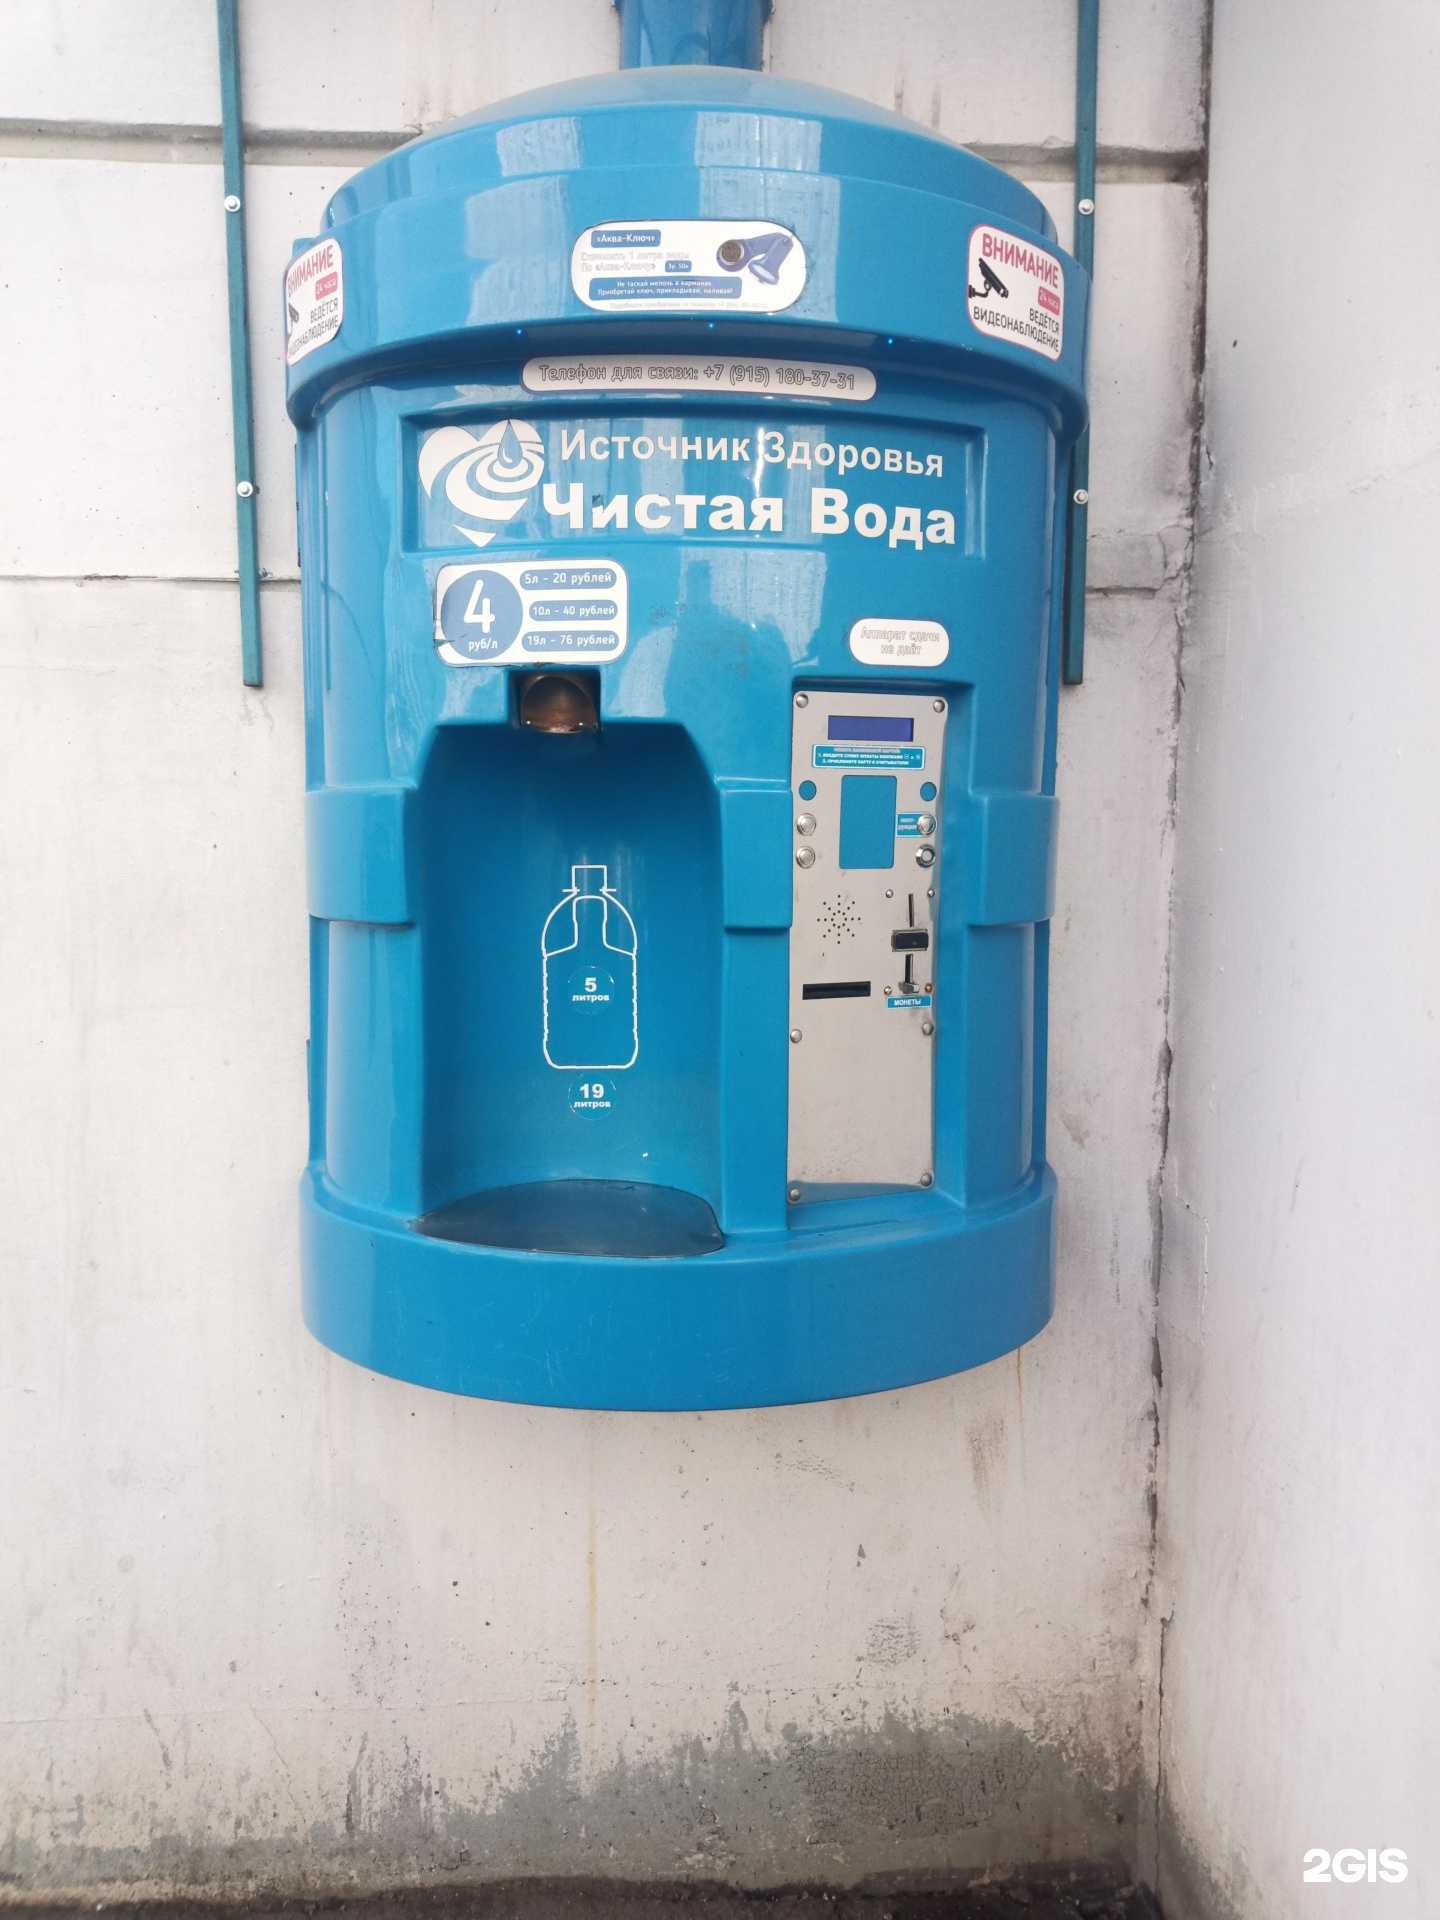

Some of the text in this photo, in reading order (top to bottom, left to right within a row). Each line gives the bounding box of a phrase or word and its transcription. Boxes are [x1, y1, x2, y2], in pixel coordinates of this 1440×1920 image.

[981, 233, 1060, 289] ВНИМАНИЕ
[973, 306, 1060, 352] ВИДЕОНАБЛЮДЕНИЕ
[538, 364, 856, 391] Телефон для связи: +7 (915) 180-37-31
[561, 428, 944, 478] Источник Здоровья
[542, 482, 956, 549] Чистая Вода
[552, 572, 567, 583] 20
[571, 571, 613, 585] рублей
[463, 578, 495, 634] 4
[532, 605, 551, 616] 10л
[563, 605, 576, 615] 40
[579, 604, 615, 617] рублей
[468, 637, 498, 653] руб/л
[527, 635, 546, 646] 19л
[560, 635, 573, 646] 76
[577, 634, 616, 648] рублей
[583, 976, 598, 993] 5
[572, 993, 610, 1003] литров
[894, 998, 922, 1008] МОНЕТЫ
[579, 1082, 604, 1099] 19
[573, 1099, 612, 1109] литров
